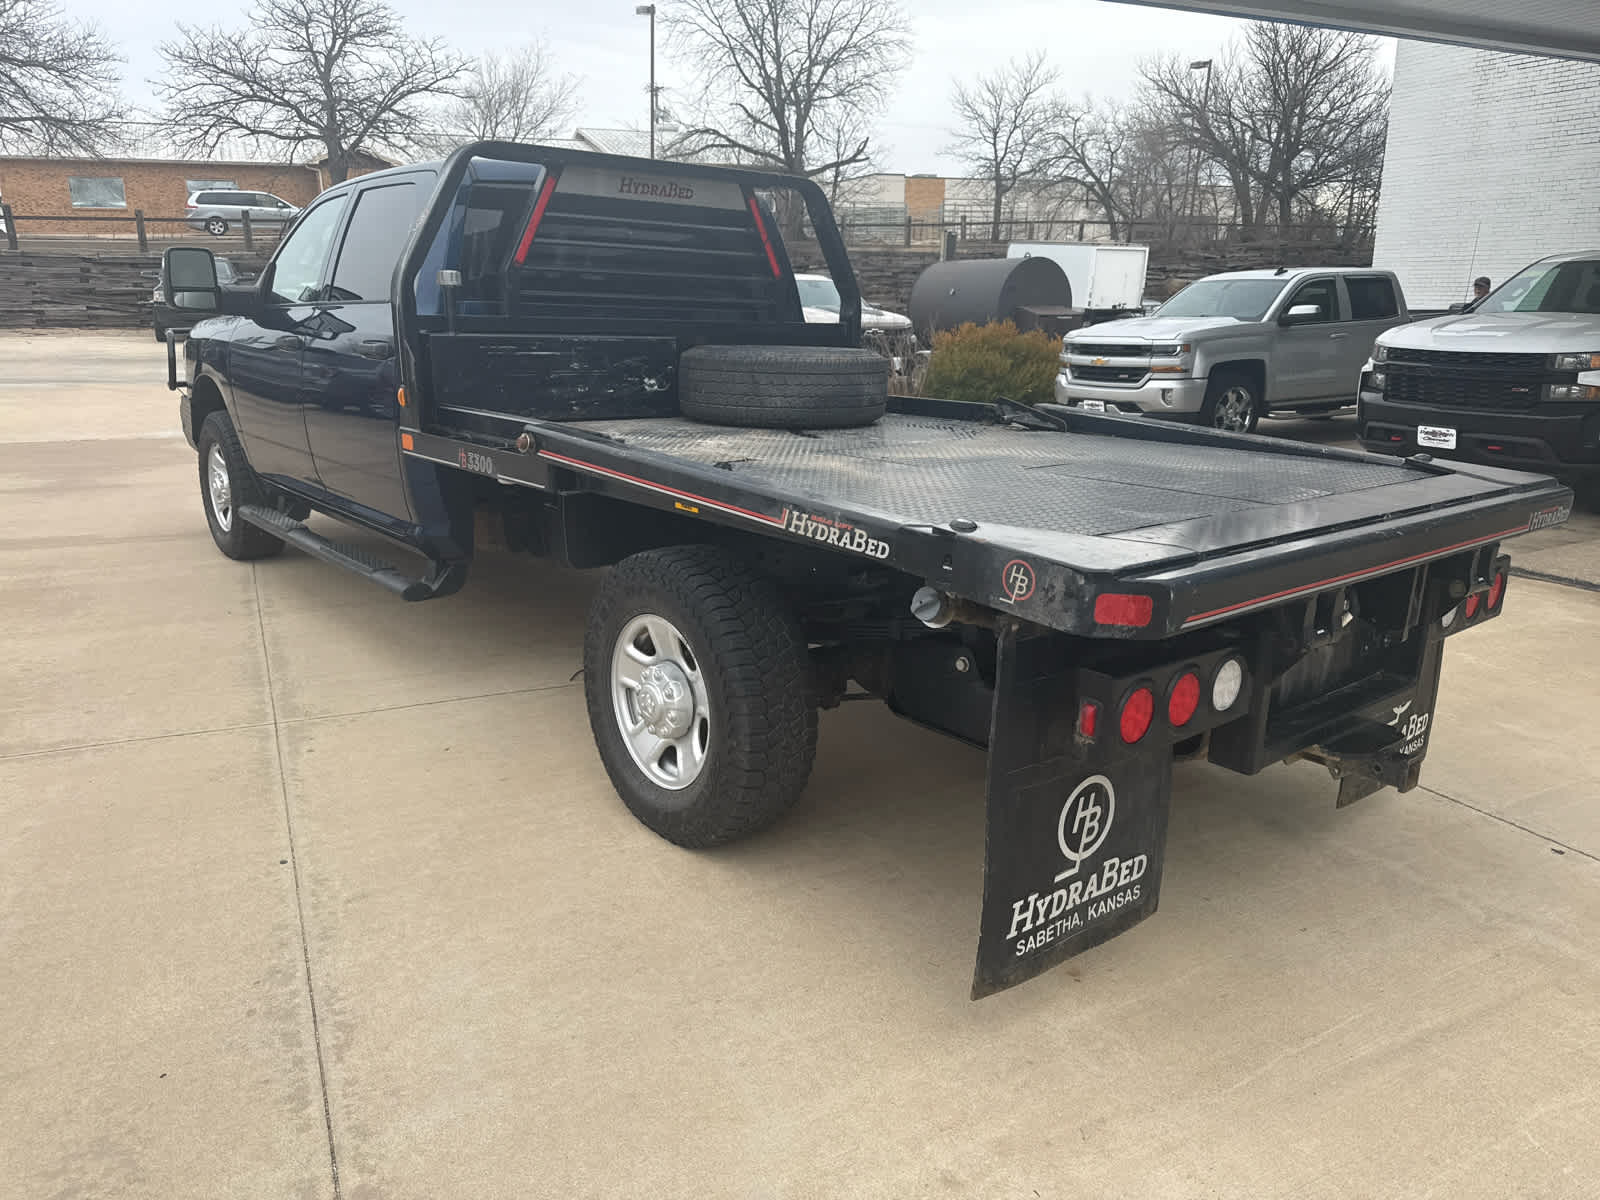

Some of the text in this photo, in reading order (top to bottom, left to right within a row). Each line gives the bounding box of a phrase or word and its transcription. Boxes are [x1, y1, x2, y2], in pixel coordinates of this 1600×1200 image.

[467, 452, 493, 474] 3300
[788, 511, 890, 559] HYDRABED
[1006, 854, 1148, 940] HYDRABED
[1015, 884, 1141, 957] SABETHA, KANSAS
